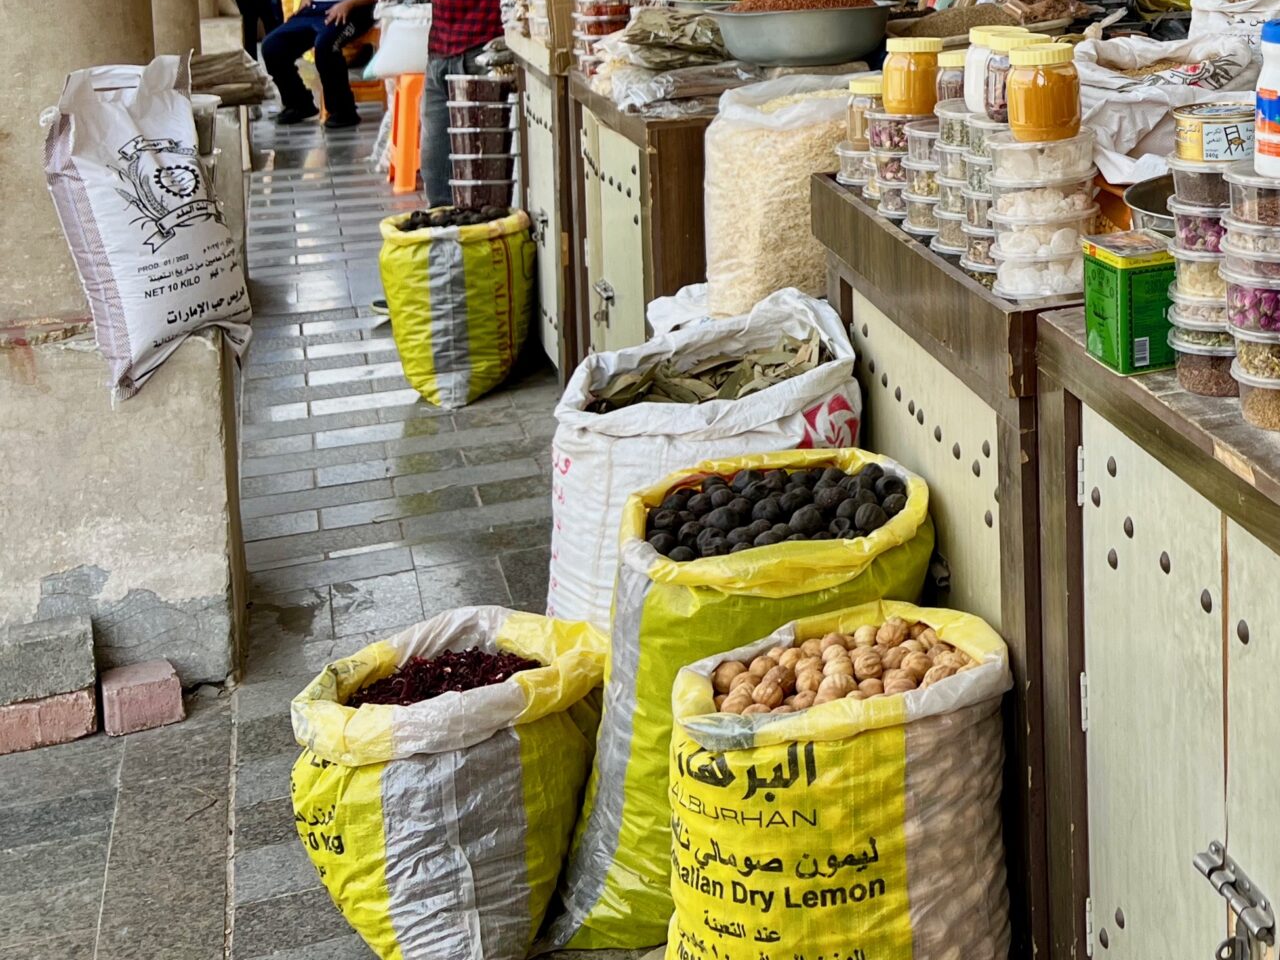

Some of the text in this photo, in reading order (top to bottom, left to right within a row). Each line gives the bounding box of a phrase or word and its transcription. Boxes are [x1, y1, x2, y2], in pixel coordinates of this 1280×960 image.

[144, 275, 201, 299] NET 10 KILO
[166, 300, 210, 324] الإمارات
[674, 739, 817, 803] البرها
[671, 781, 818, 829] ALBURHAN
[694, 837, 784, 878] صومالي
[795, 836, 880, 880] ليمون
[732, 880, 775, 913] Dry
[784, 877, 886, 909] Lemon
[703, 908, 782, 943] عند التعبئة
